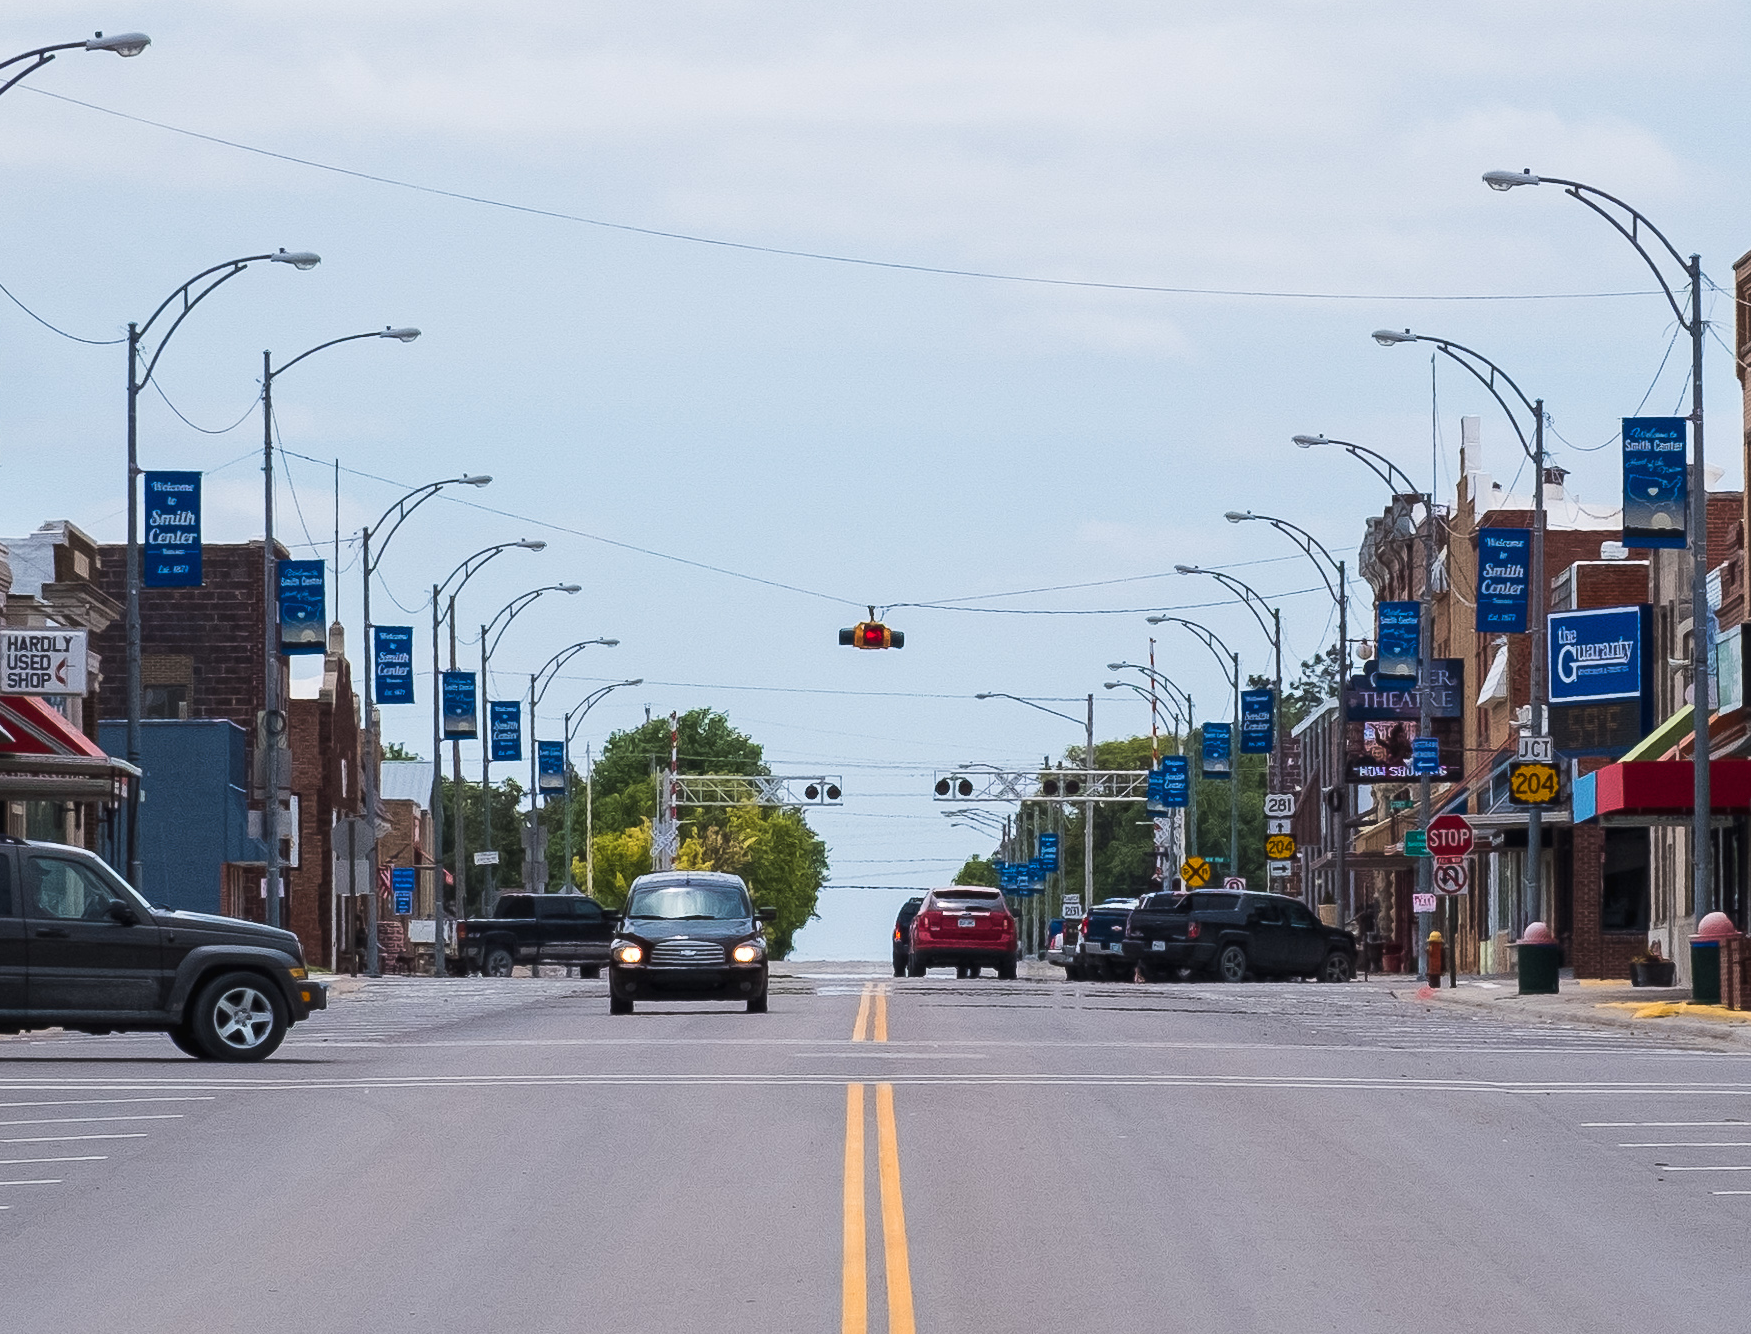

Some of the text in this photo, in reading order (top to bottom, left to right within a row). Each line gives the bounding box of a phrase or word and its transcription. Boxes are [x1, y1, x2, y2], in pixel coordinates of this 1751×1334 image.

[1625, 439, 1684, 451] Smith Center
[151, 481, 195, 492] Welcome
[150, 509, 196, 526] Smith
[149, 528, 197, 544] Center
[1484, 537, 1524, 547] Welcome
[1483, 563, 1524, 578] Smith
[1481, 579, 1525, 595] Center
[1558, 626, 1577, 644] the
[7, 636, 74, 652] HARDLY
[7, 654, 52, 671] USED
[378, 652, 409, 663] Smith
[1558, 636, 1634, 683] Guaranty
[378, 664, 410, 676] Center
[7, 673, 52, 689] SHOP
[1359, 691, 1454, 709] THEATRE
[1520, 740, 1550, 759] JCT
[1515, 772, 1555, 794] 204
[1268, 798, 1292, 812] 281
[1429, 829, 1469, 847] STOP
[1269, 839, 1293, 854] 204
